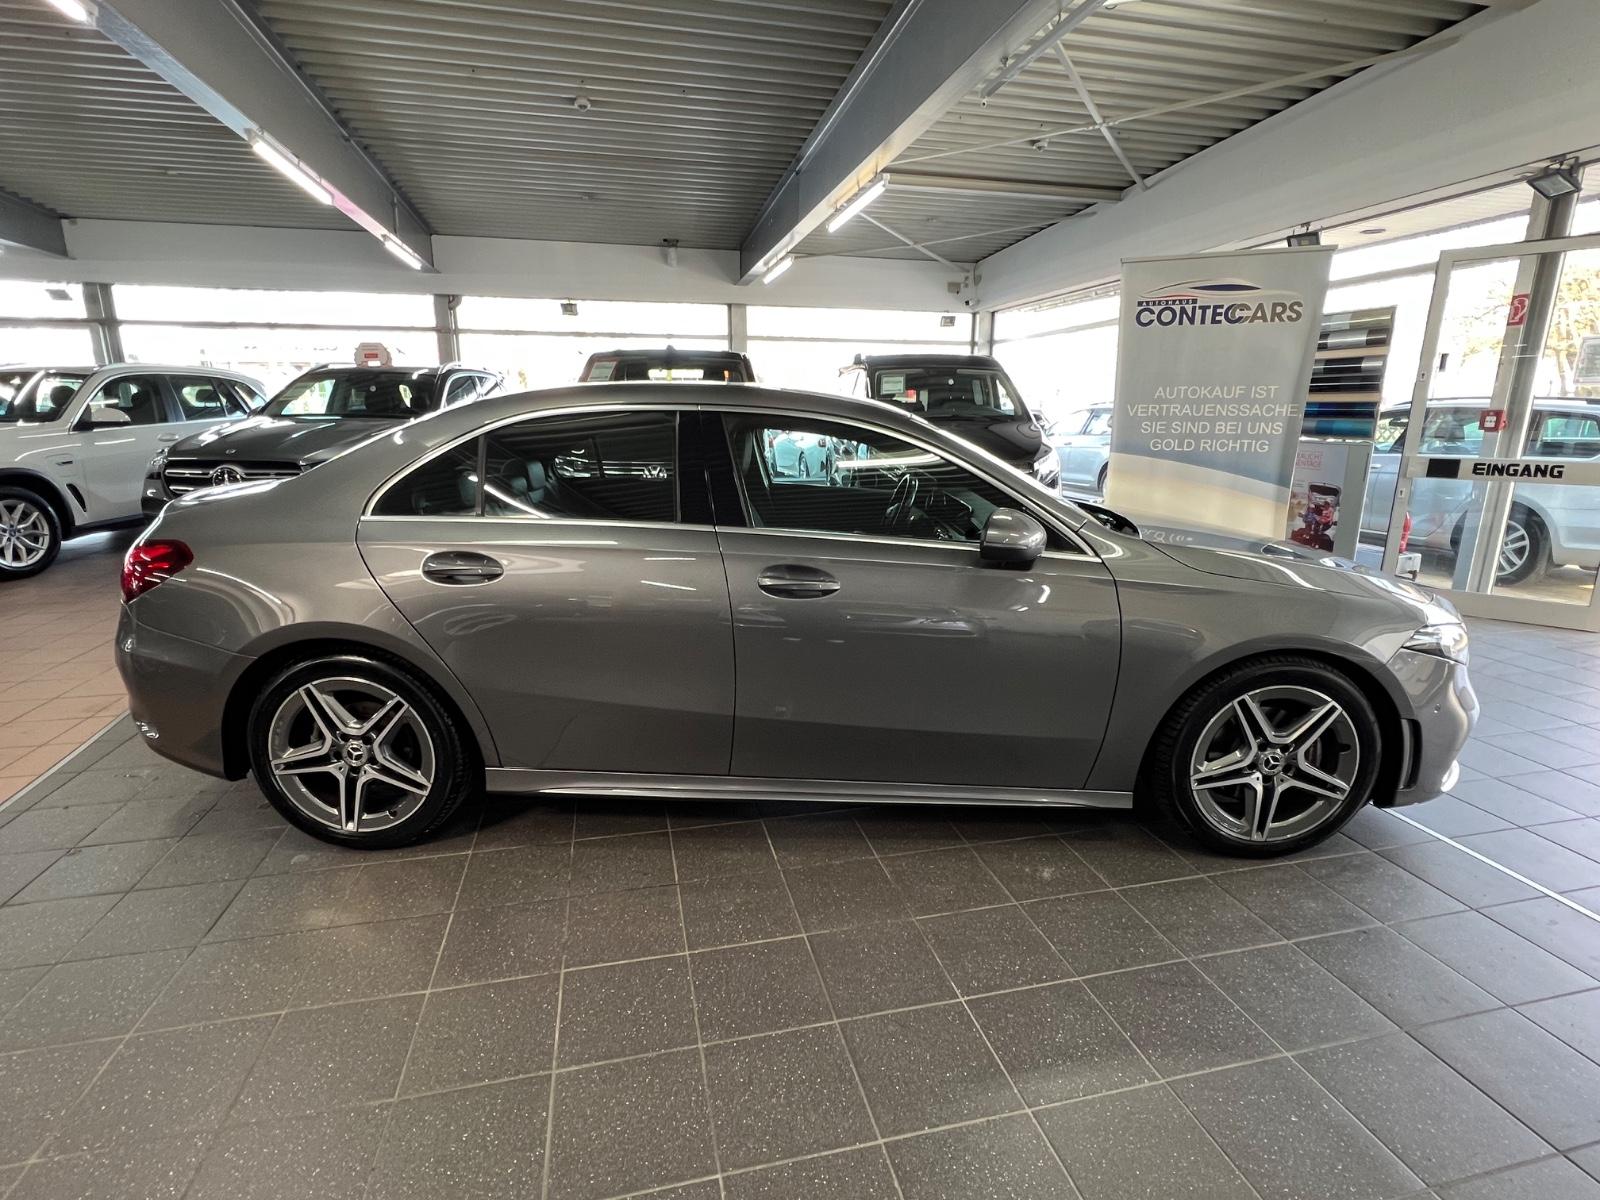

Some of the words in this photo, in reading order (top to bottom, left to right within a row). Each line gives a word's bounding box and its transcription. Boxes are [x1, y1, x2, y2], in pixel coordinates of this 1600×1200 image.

[1154, 385, 1248, 399] AUTOKAUF
[1250, 385, 1281, 399] IST
[1140, 421, 1168, 434] SIE
[1171, 421, 1210, 434] SIND
[1215, 421, 1242, 434] BEI
[1247, 421, 1284, 435] UNS
[1150, 438, 1195, 451] GOLD
[1199, 439, 1270, 452] RICHTIG
[1472, 462, 1565, 479] EINGANG
